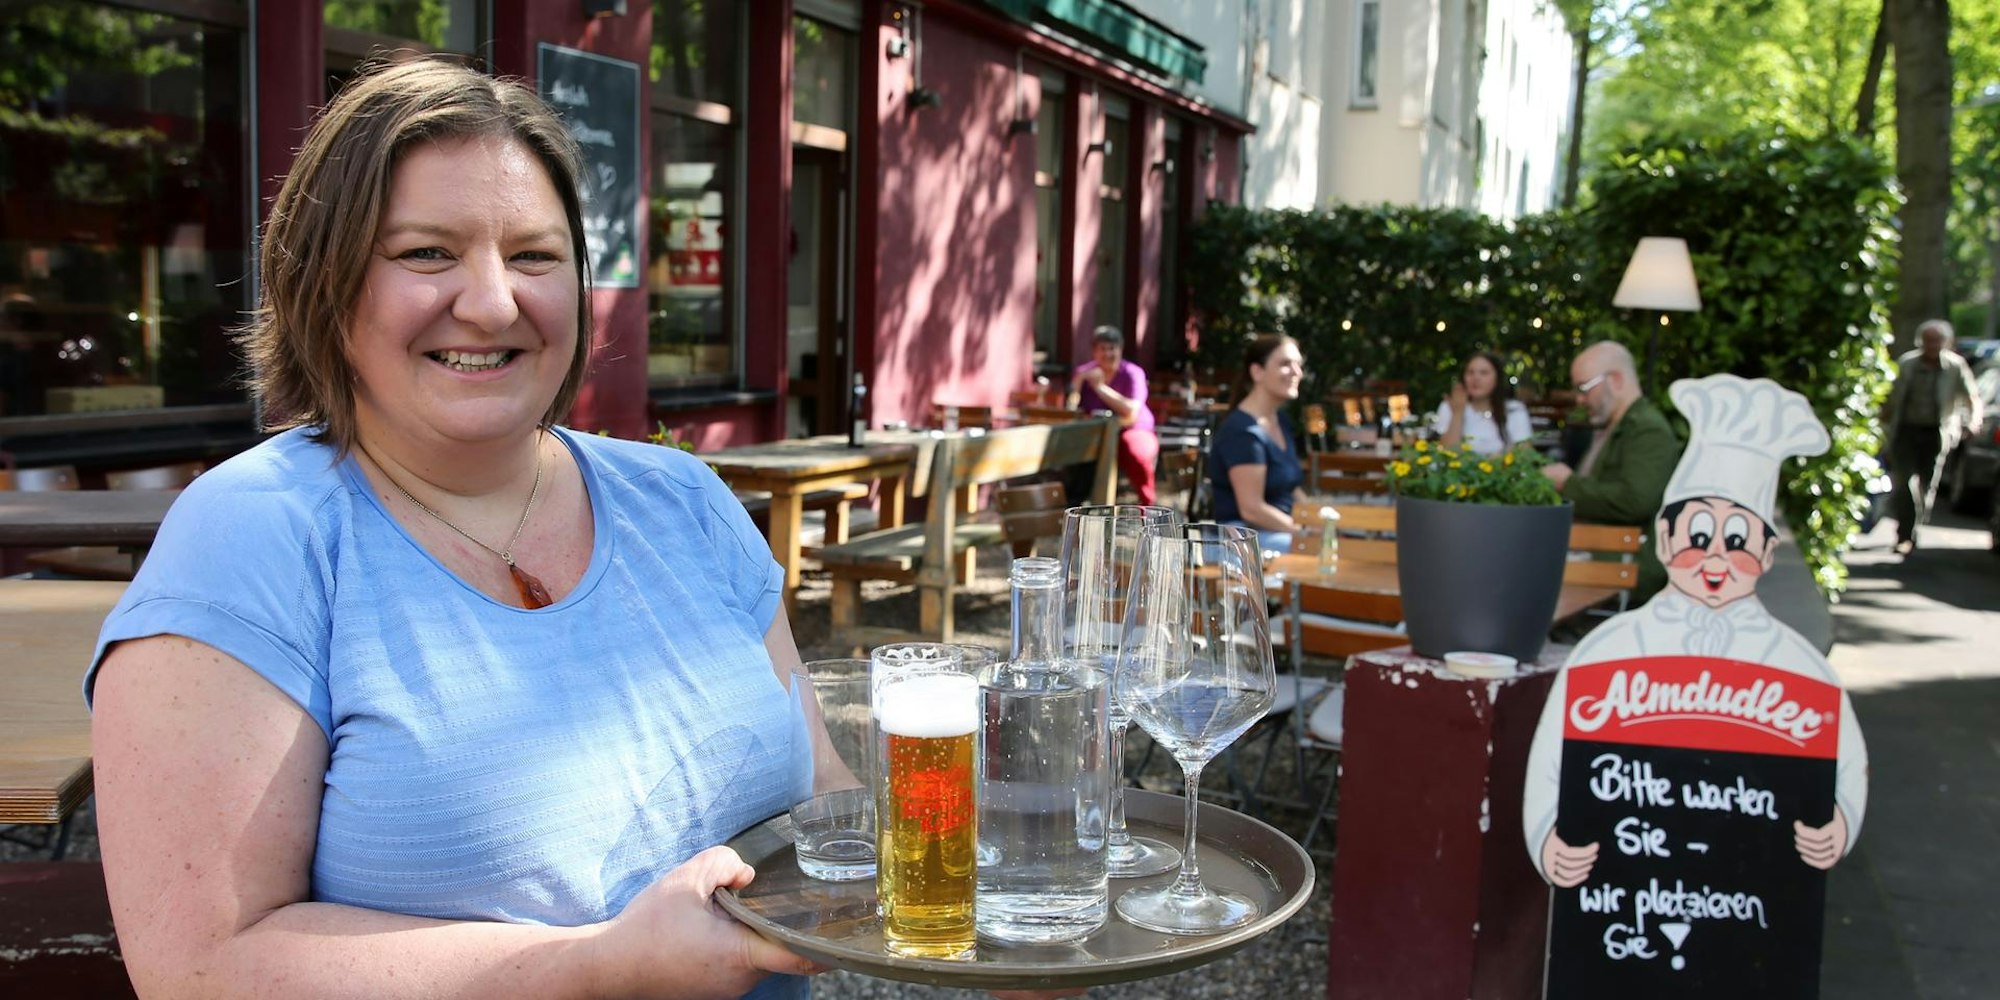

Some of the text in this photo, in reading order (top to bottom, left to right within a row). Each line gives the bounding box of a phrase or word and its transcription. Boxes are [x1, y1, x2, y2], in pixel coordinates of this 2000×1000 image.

[1570, 670, 1822, 739] Almdudler
[1589, 753, 1779, 820] Bitte warten
[1614, 816, 1671, 857] Sie
[1579, 877, 1768, 935] wir platzieren
